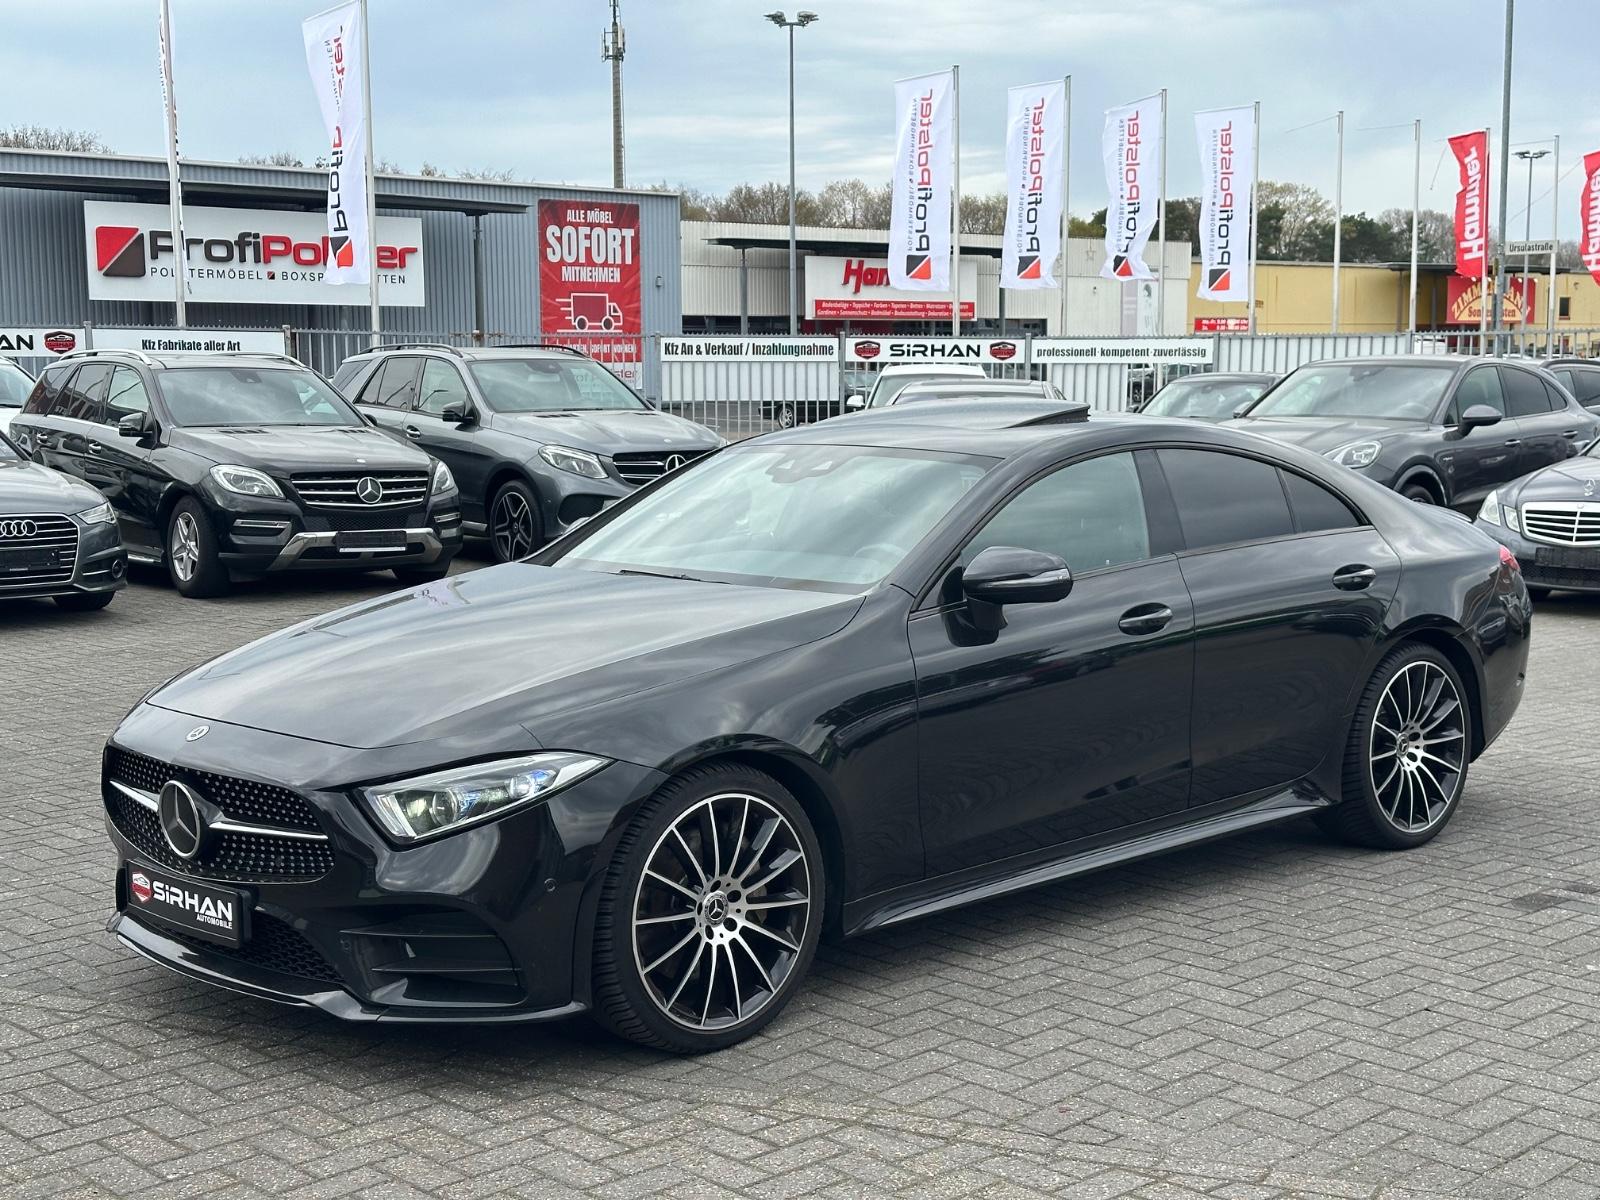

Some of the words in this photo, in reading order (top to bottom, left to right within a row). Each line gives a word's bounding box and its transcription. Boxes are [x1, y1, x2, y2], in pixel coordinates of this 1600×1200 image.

[566, 209, 585, 223] ALLE
[586, 208, 614, 224] MÖBEL
[149, 230, 418, 269] ProfiPoler
[545, 224, 635, 265] SOFORT
[1509, 243, 1553, 253] Ursulastraße
[150, 267, 263, 281] POLTERMÖBEL
[561, 265, 621, 283] MITNEHMEN
[141, 339, 156, 351] Kfz
[157, 339, 202, 351] Fabrikate
[203, 340, 225, 351] aller
[227, 340, 241, 352] Art
[664, 342, 679, 356] Kfz
[681, 343, 693, 356] An
[695, 343, 702, 356] &
[704, 342, 744, 356] Verkauf
[745, 342, 750, 356] /
[752, 342, 834, 357] Inzahlungnahme
[1037, 347, 1097, 358] professionell
[1100, 347, 1150, 358] kompetent
[1153, 347, 1207, 358] zuverlässig
[196, 914, 233, 930] AUTOMOBILE
